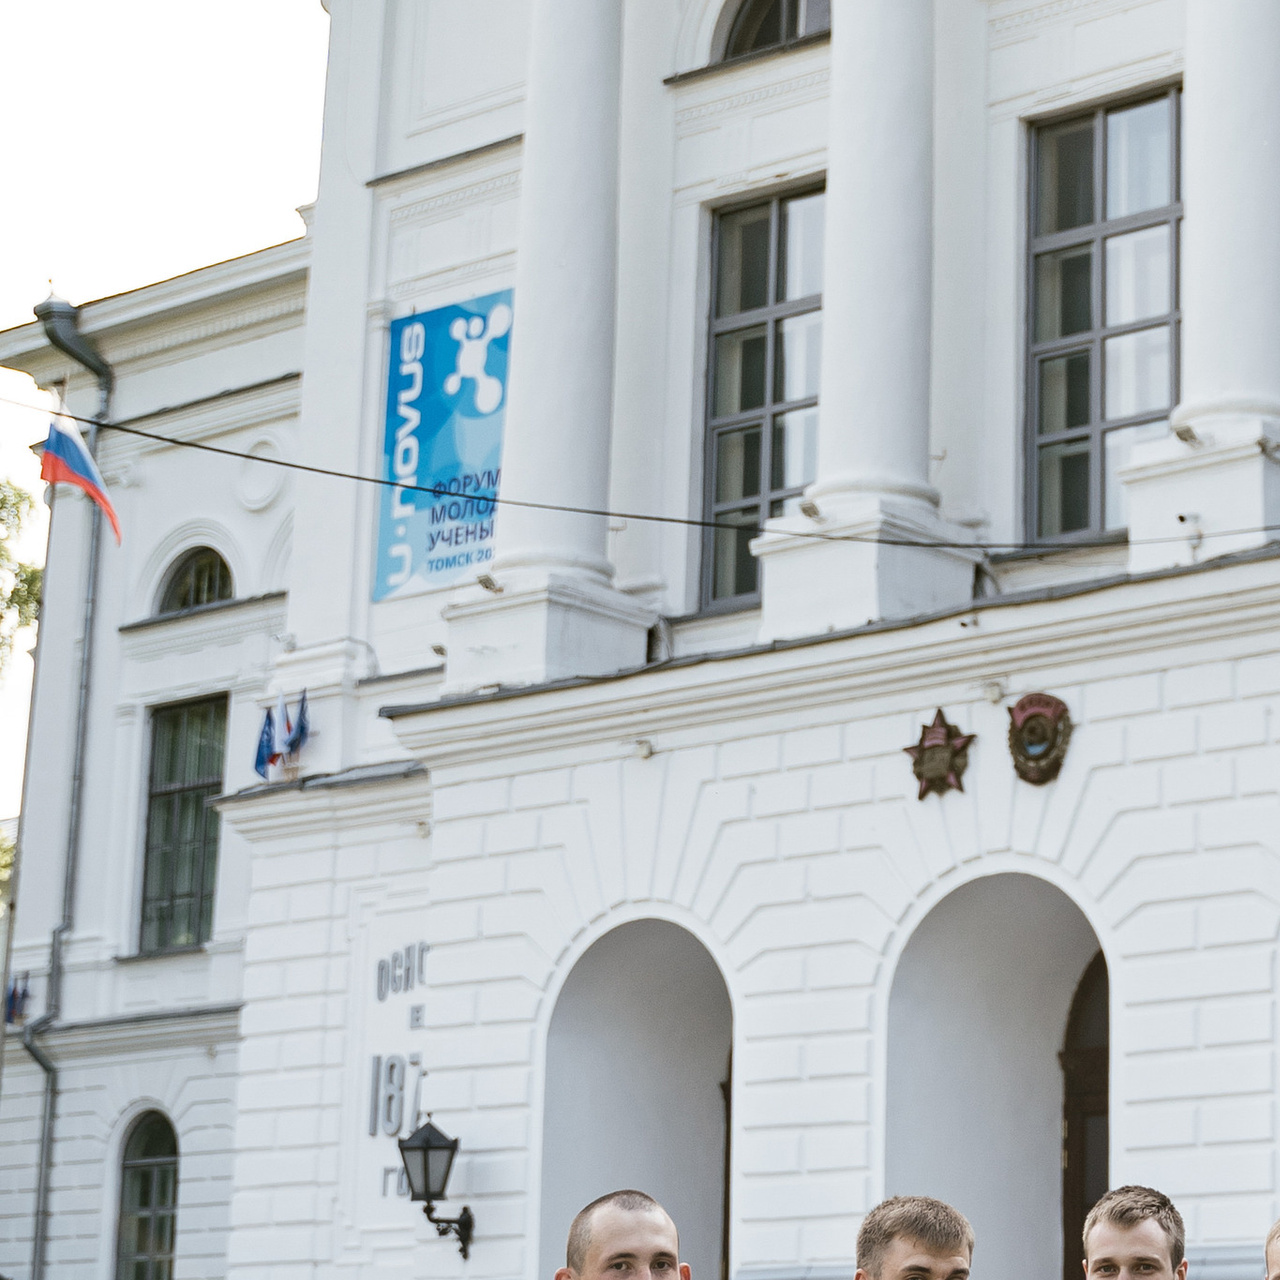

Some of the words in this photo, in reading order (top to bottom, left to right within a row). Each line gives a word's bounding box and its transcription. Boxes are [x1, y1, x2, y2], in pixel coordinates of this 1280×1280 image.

[432, 468, 501, 500] ФОРУМ
[428, 552, 473, 573] ТОМСК
[477, 547, 495, 562] 20
